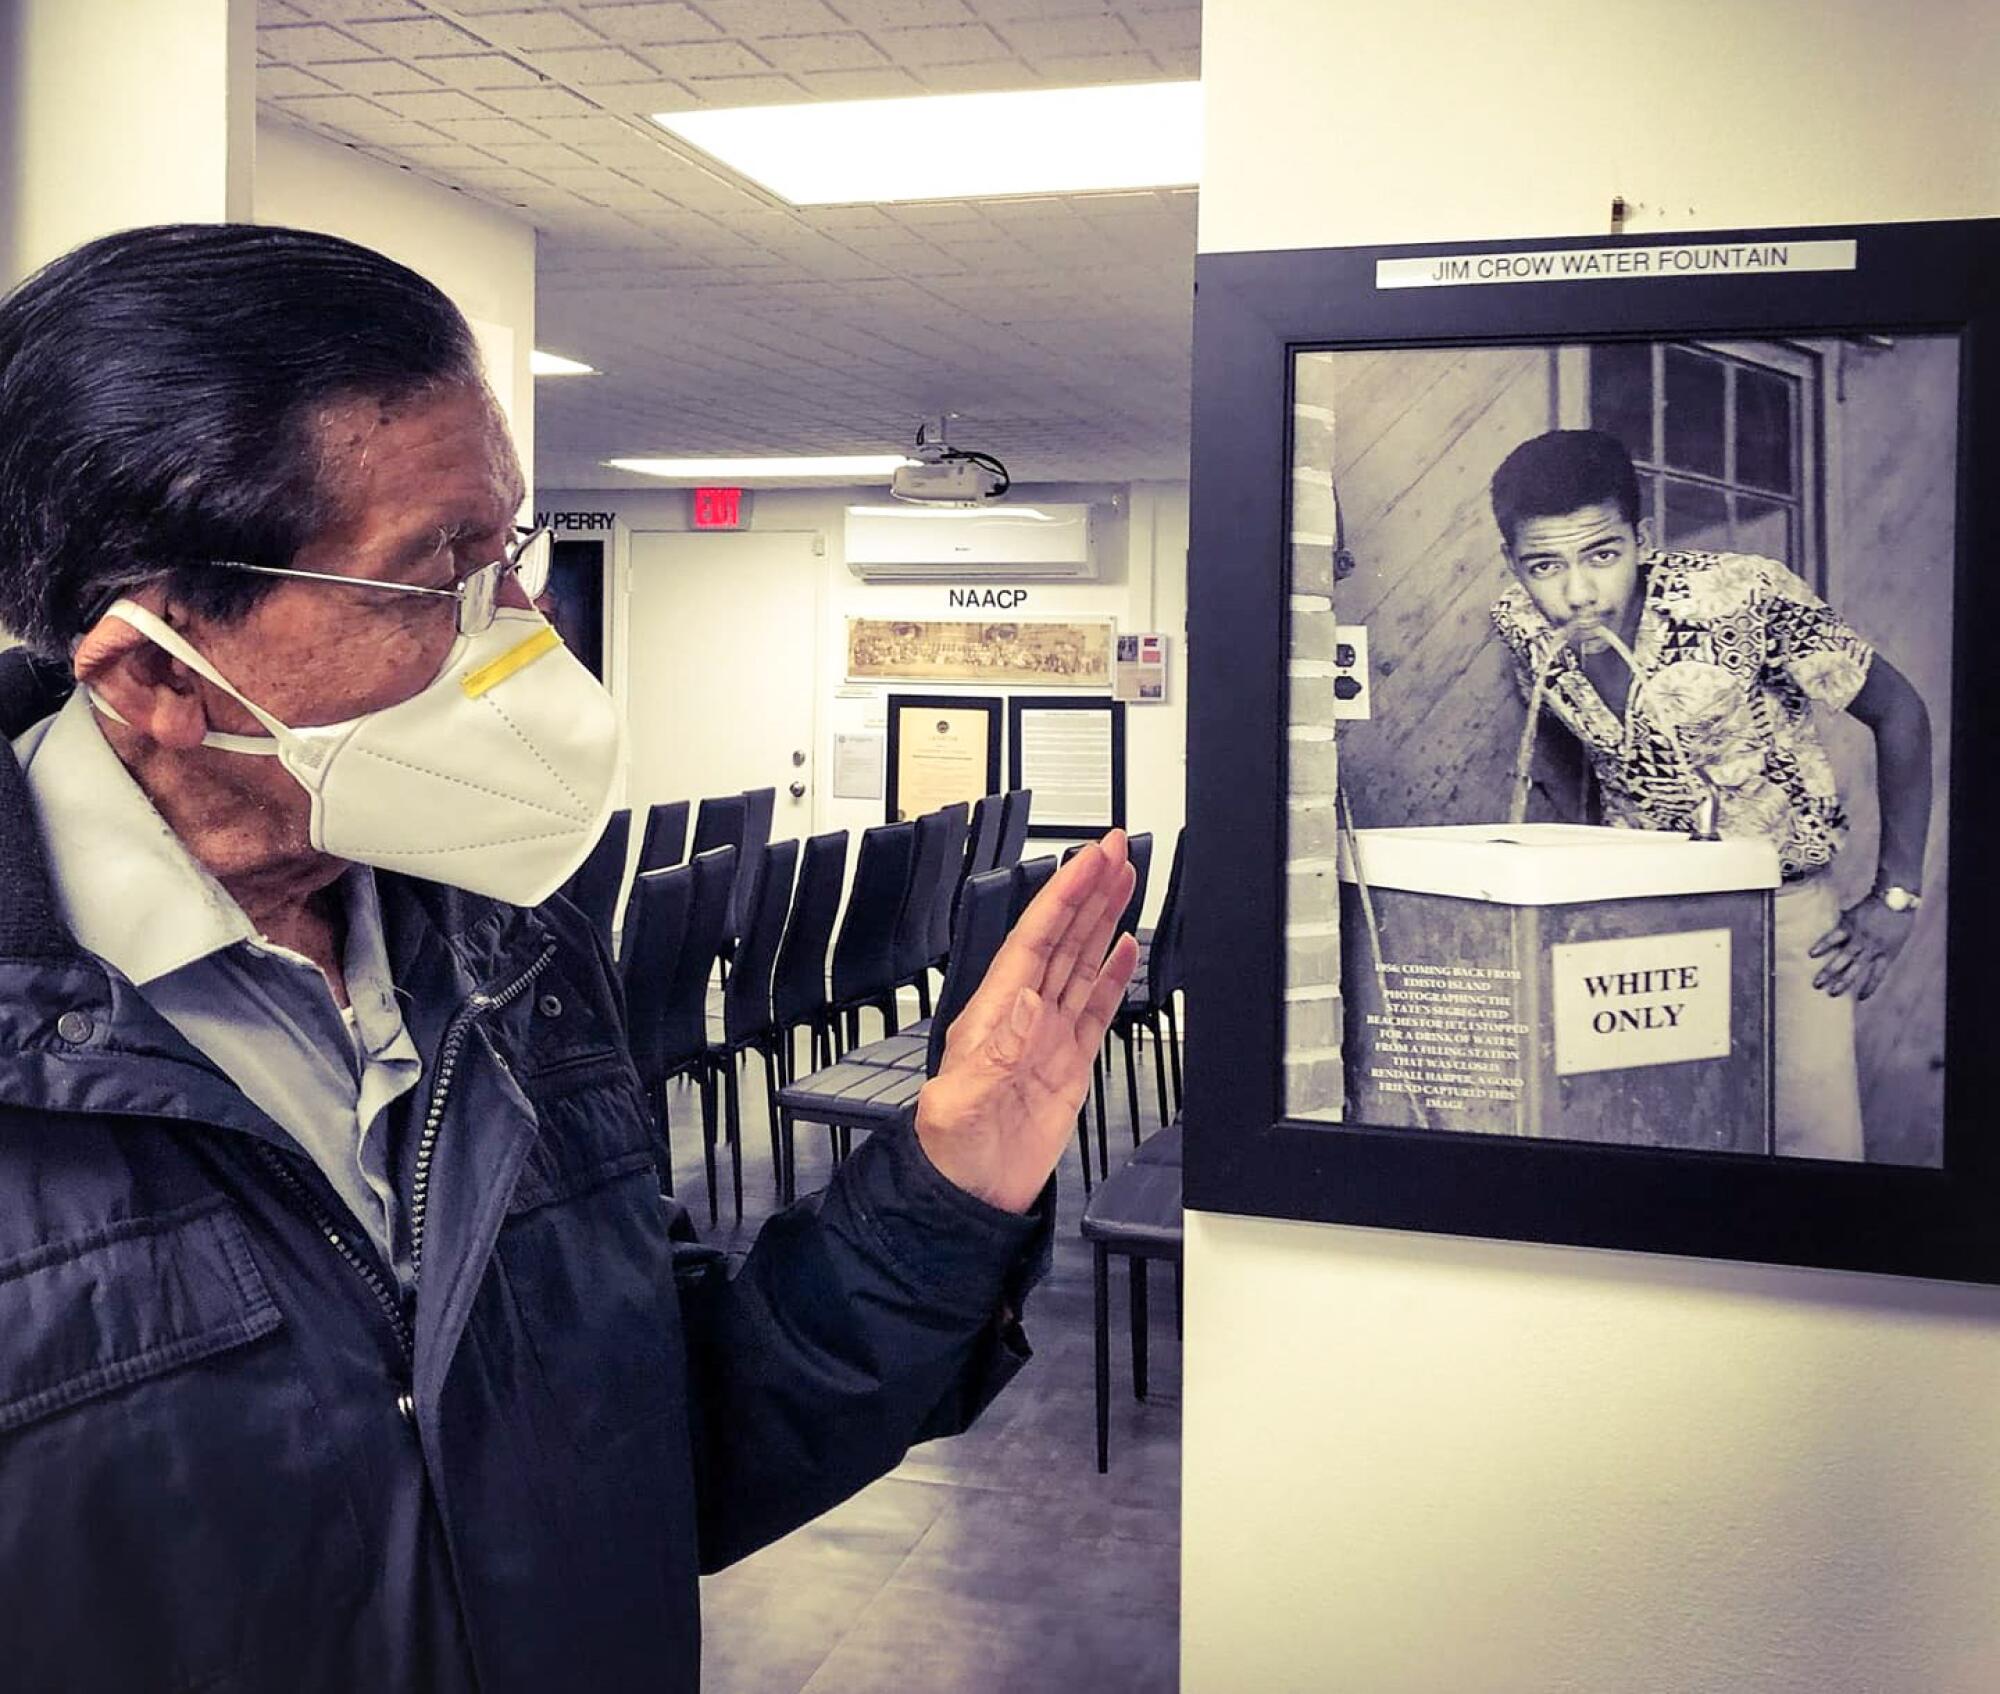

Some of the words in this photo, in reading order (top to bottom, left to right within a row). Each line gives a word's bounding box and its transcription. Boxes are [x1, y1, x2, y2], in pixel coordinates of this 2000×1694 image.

[1432, 262, 1470, 281] JIM
[1477, 256, 1555, 280] CROW
[1561, 252, 1650, 275] WATER
[1659, 247, 1789, 271] FOUNTAIN
[554, 512, 616, 530] PERRY
[949, 589, 1028, 609] NAACP
[1402, 964, 1450, 976] COMING
[1453, 967, 1486, 977] BACK
[1487, 969, 1521, 980] FROM
[1404, 977, 1446, 989] EDISTO
[1448, 980, 1491, 991] ISLAND
[1584, 966, 1699, 998] WHITE
[1382, 989, 1486, 1005] PHOTOGRAPHING
[1488, 995, 1512, 1006] THE
[1432, 1006, 1510, 1019] SEGREGATED
[1592, 1003, 1685, 1034] ONLY
[1420, 1017, 1443, 1029] FOR
[1475, 1022, 1529, 1034] STOPPED
[1380, 1029, 1403, 1040] FOR
[1406, 1030, 1414, 1041] A
[1415, 1031, 1452, 1043] DRINK
[1473, 1035, 1519, 1047] WATER
[1375, 1042, 1409, 1052] FROM
[1410, 1045, 1419, 1054] A
[1420, 1045, 1466, 1057] FILLING
[1467, 1049, 1520, 1060] STATION
[1393, 1056, 1424, 1067] THAT
[1426, 1058, 1452, 1069] WAS
[1478, 1075, 1486, 1085] A
[1378, 1082, 1422, 1094] FRIEND
[1423, 1085, 1487, 1098] CAPTURED
[1489, 1089, 1516, 1100] THIS
